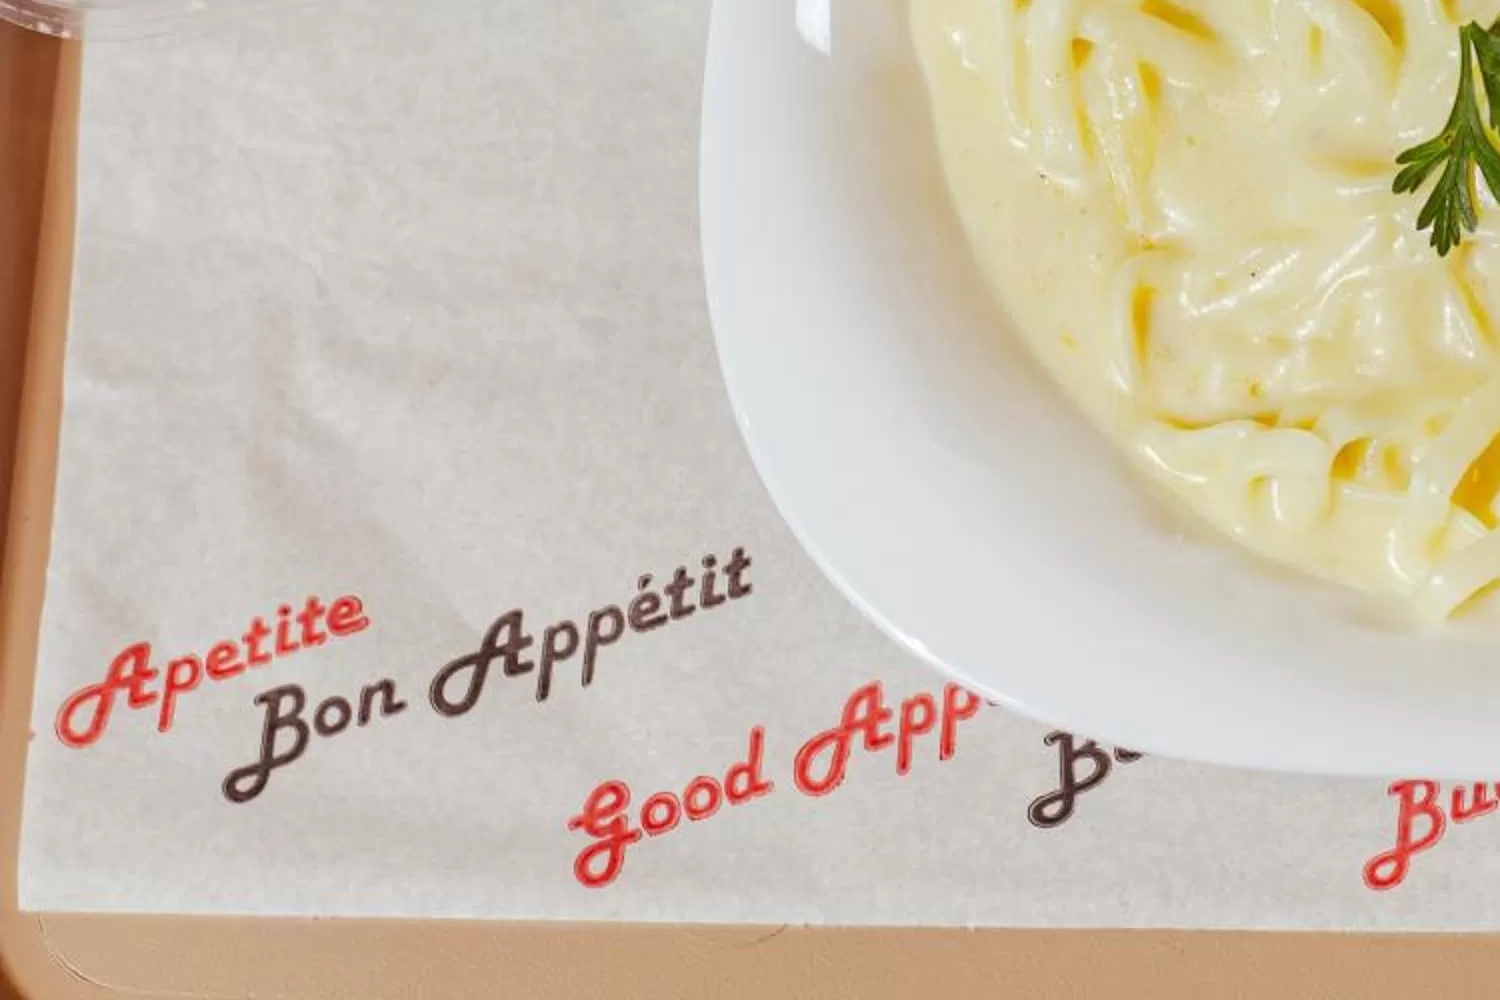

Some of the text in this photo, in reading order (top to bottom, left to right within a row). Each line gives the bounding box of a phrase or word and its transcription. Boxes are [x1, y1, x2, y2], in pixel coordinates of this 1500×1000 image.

[55, 595, 373, 749] Apetite
[222, 546, 754, 804] Bon Appétit
[566, 680, 992, 889] Good App
